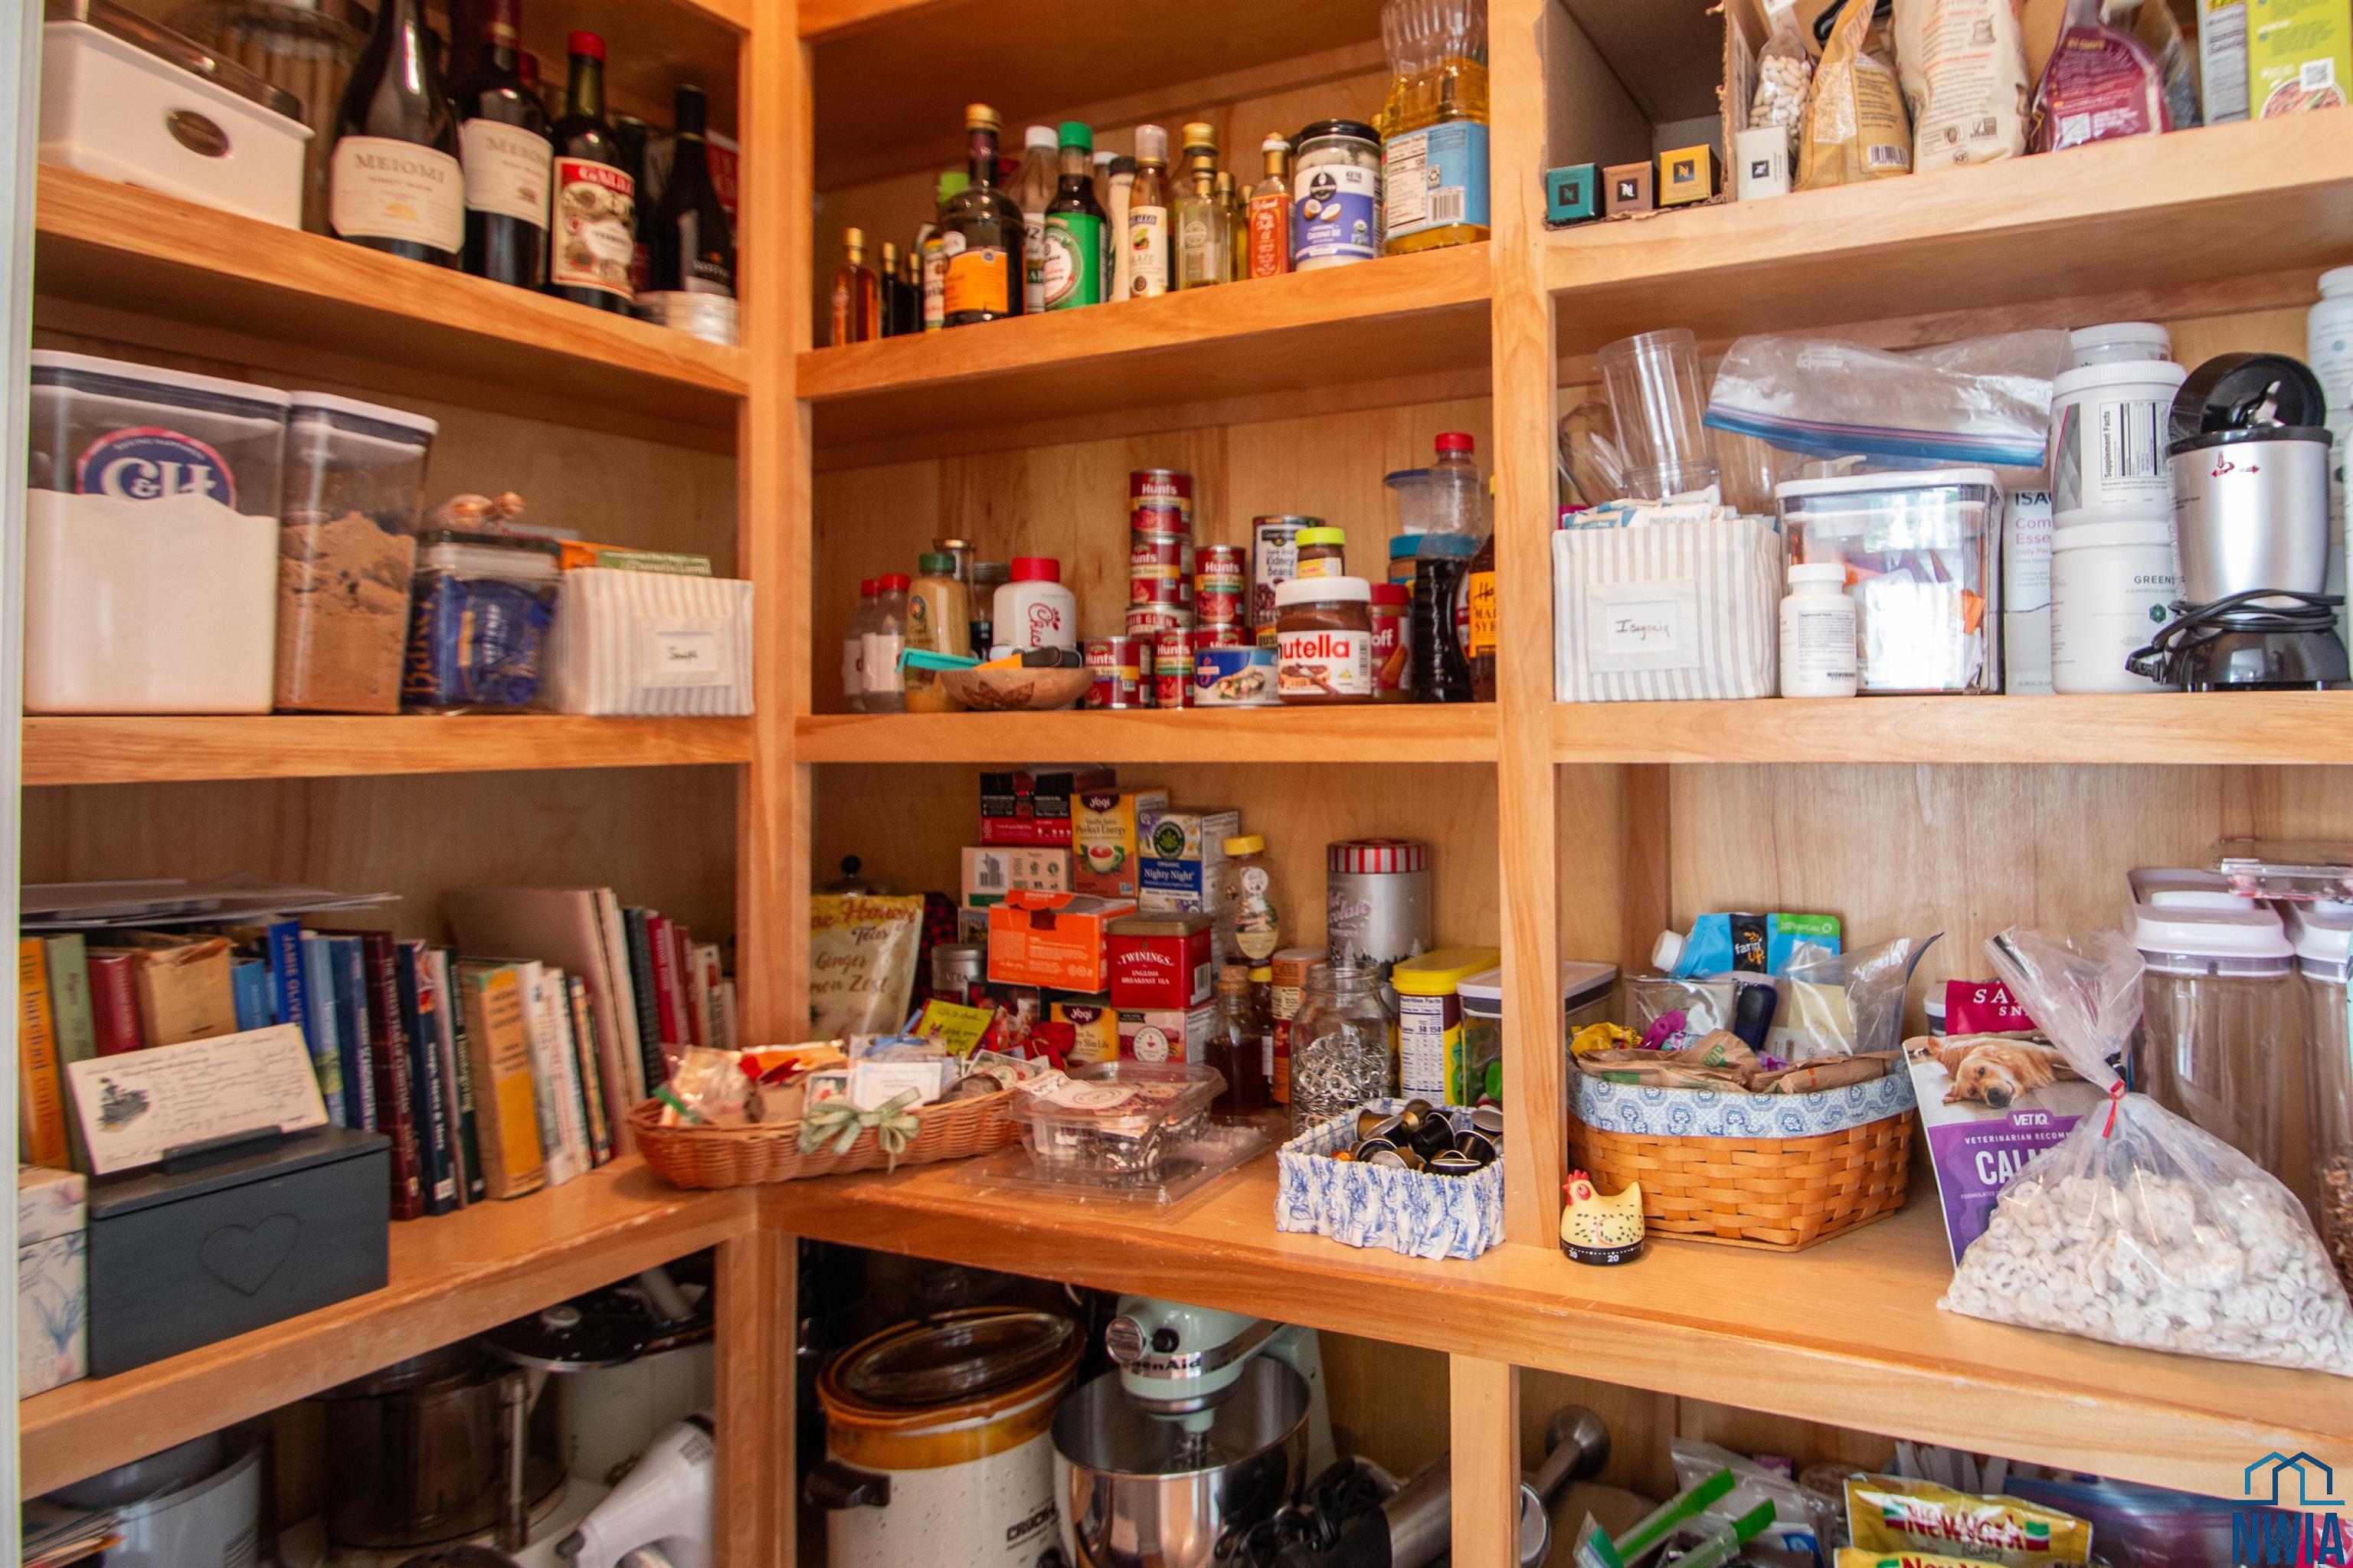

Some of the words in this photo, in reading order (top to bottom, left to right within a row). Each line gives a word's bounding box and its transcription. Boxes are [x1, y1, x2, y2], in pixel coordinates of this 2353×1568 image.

[355, 153, 444, 183] MEIOMI
[1266, 556, 1294, 568] Kidney
[1268, 567, 1294, 576] Beans
[1075, 824, 1100, 834] Perfect
[1101, 826, 1126, 836] Energy
[1144, 868, 1169, 881] Nighty
[1170, 870, 1193, 882] Night
[1119, 951, 1172, 965] TWININGS
[1121, 976, 1157, 985] BREAKFAST
[1964, 1132, 2032, 1145] VETERINARIAN
[1607, 1254, 1619, 1263] 20
